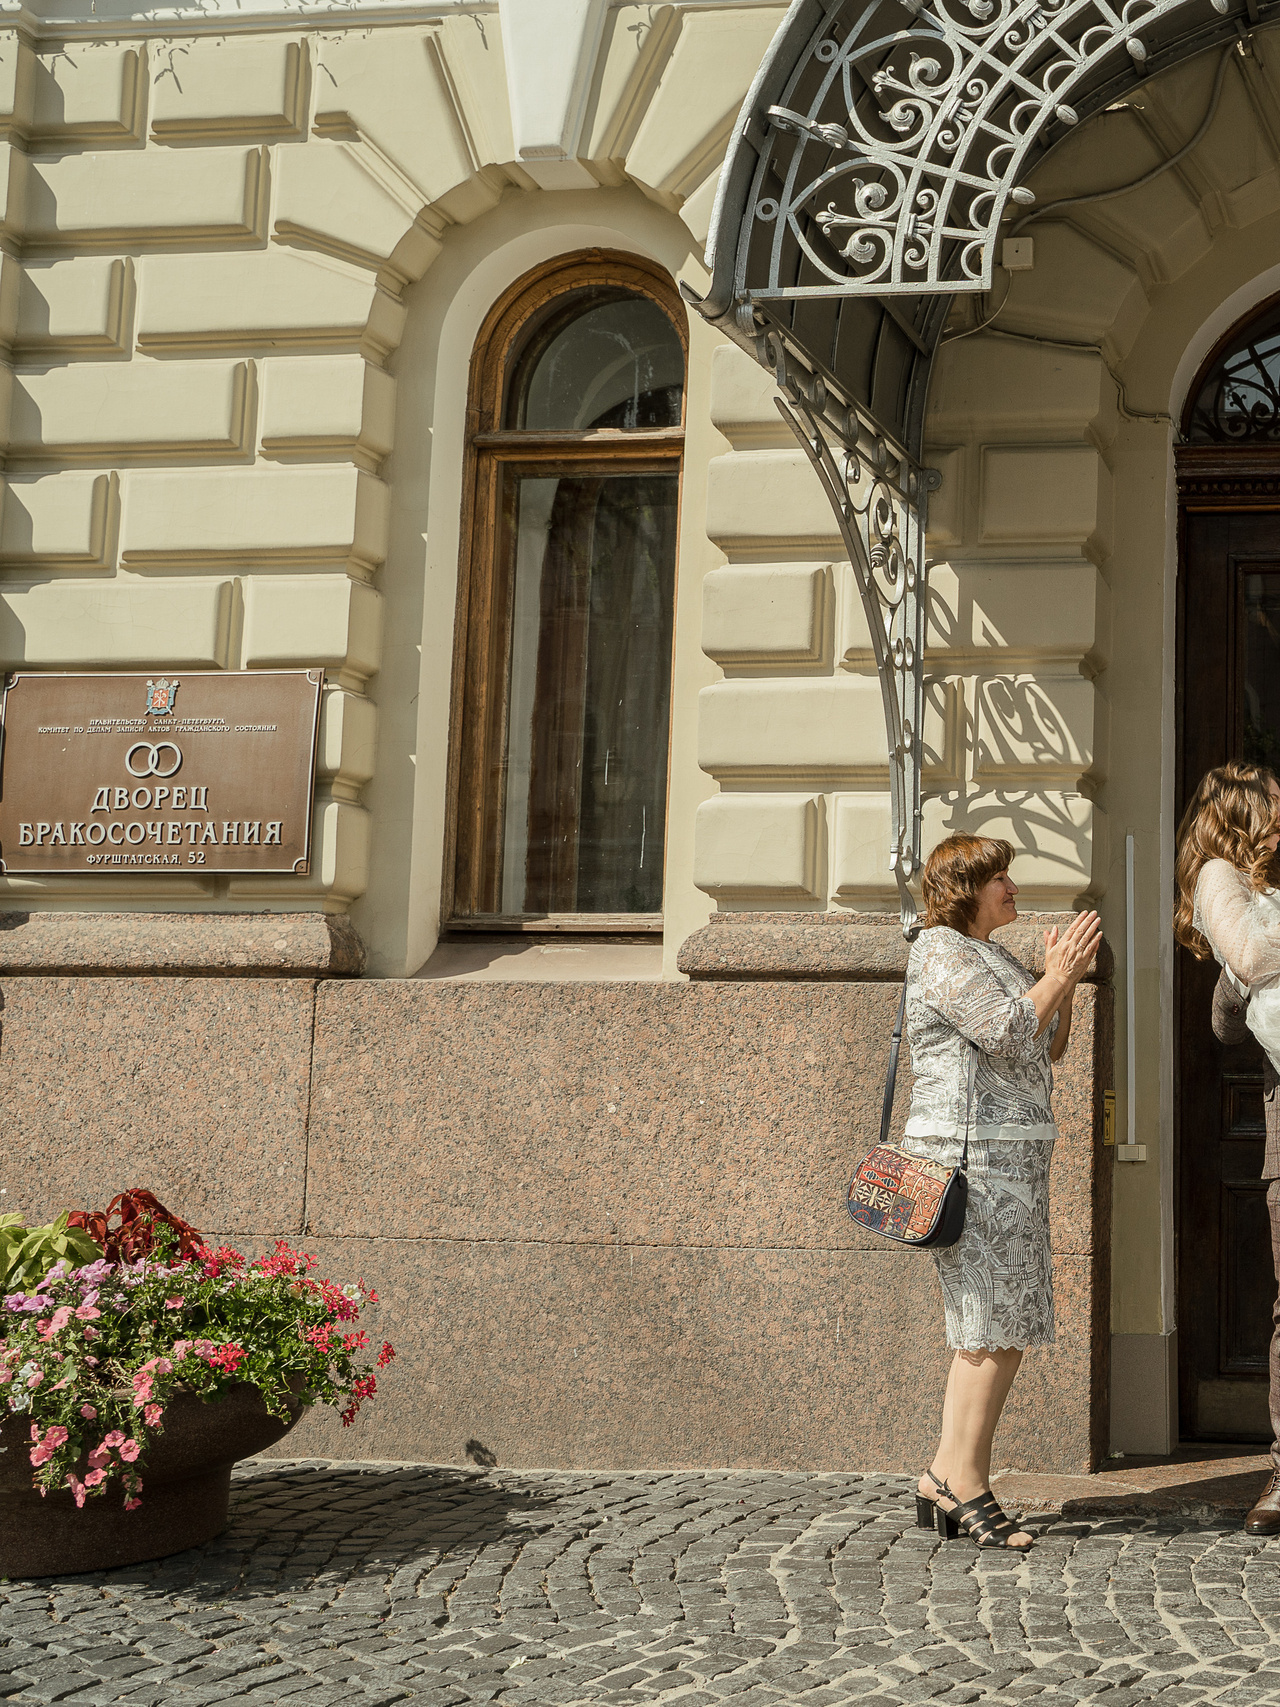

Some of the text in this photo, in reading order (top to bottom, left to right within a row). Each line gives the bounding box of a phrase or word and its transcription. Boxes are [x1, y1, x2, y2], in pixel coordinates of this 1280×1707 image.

[38, 726, 70, 734] КОМИТЕТ
[87, 726, 112, 734] ДЕЛАМ
[148, 725, 171, 733] АКТОВ
[175, 725, 230, 733] ГРАЖДАНСКОГО
[90, 718, 225, 726] ПРАВИТЕЛЬСТВО САНКТ-ПЕТЕРБУРГА
[90, 786, 209, 813] ДВОРЕЦ
[18, 821, 284, 847] БРАКОСОЧЕТАНИЯ
[86, 851, 207, 866] ФУРШТАТСКАЯ, 52
